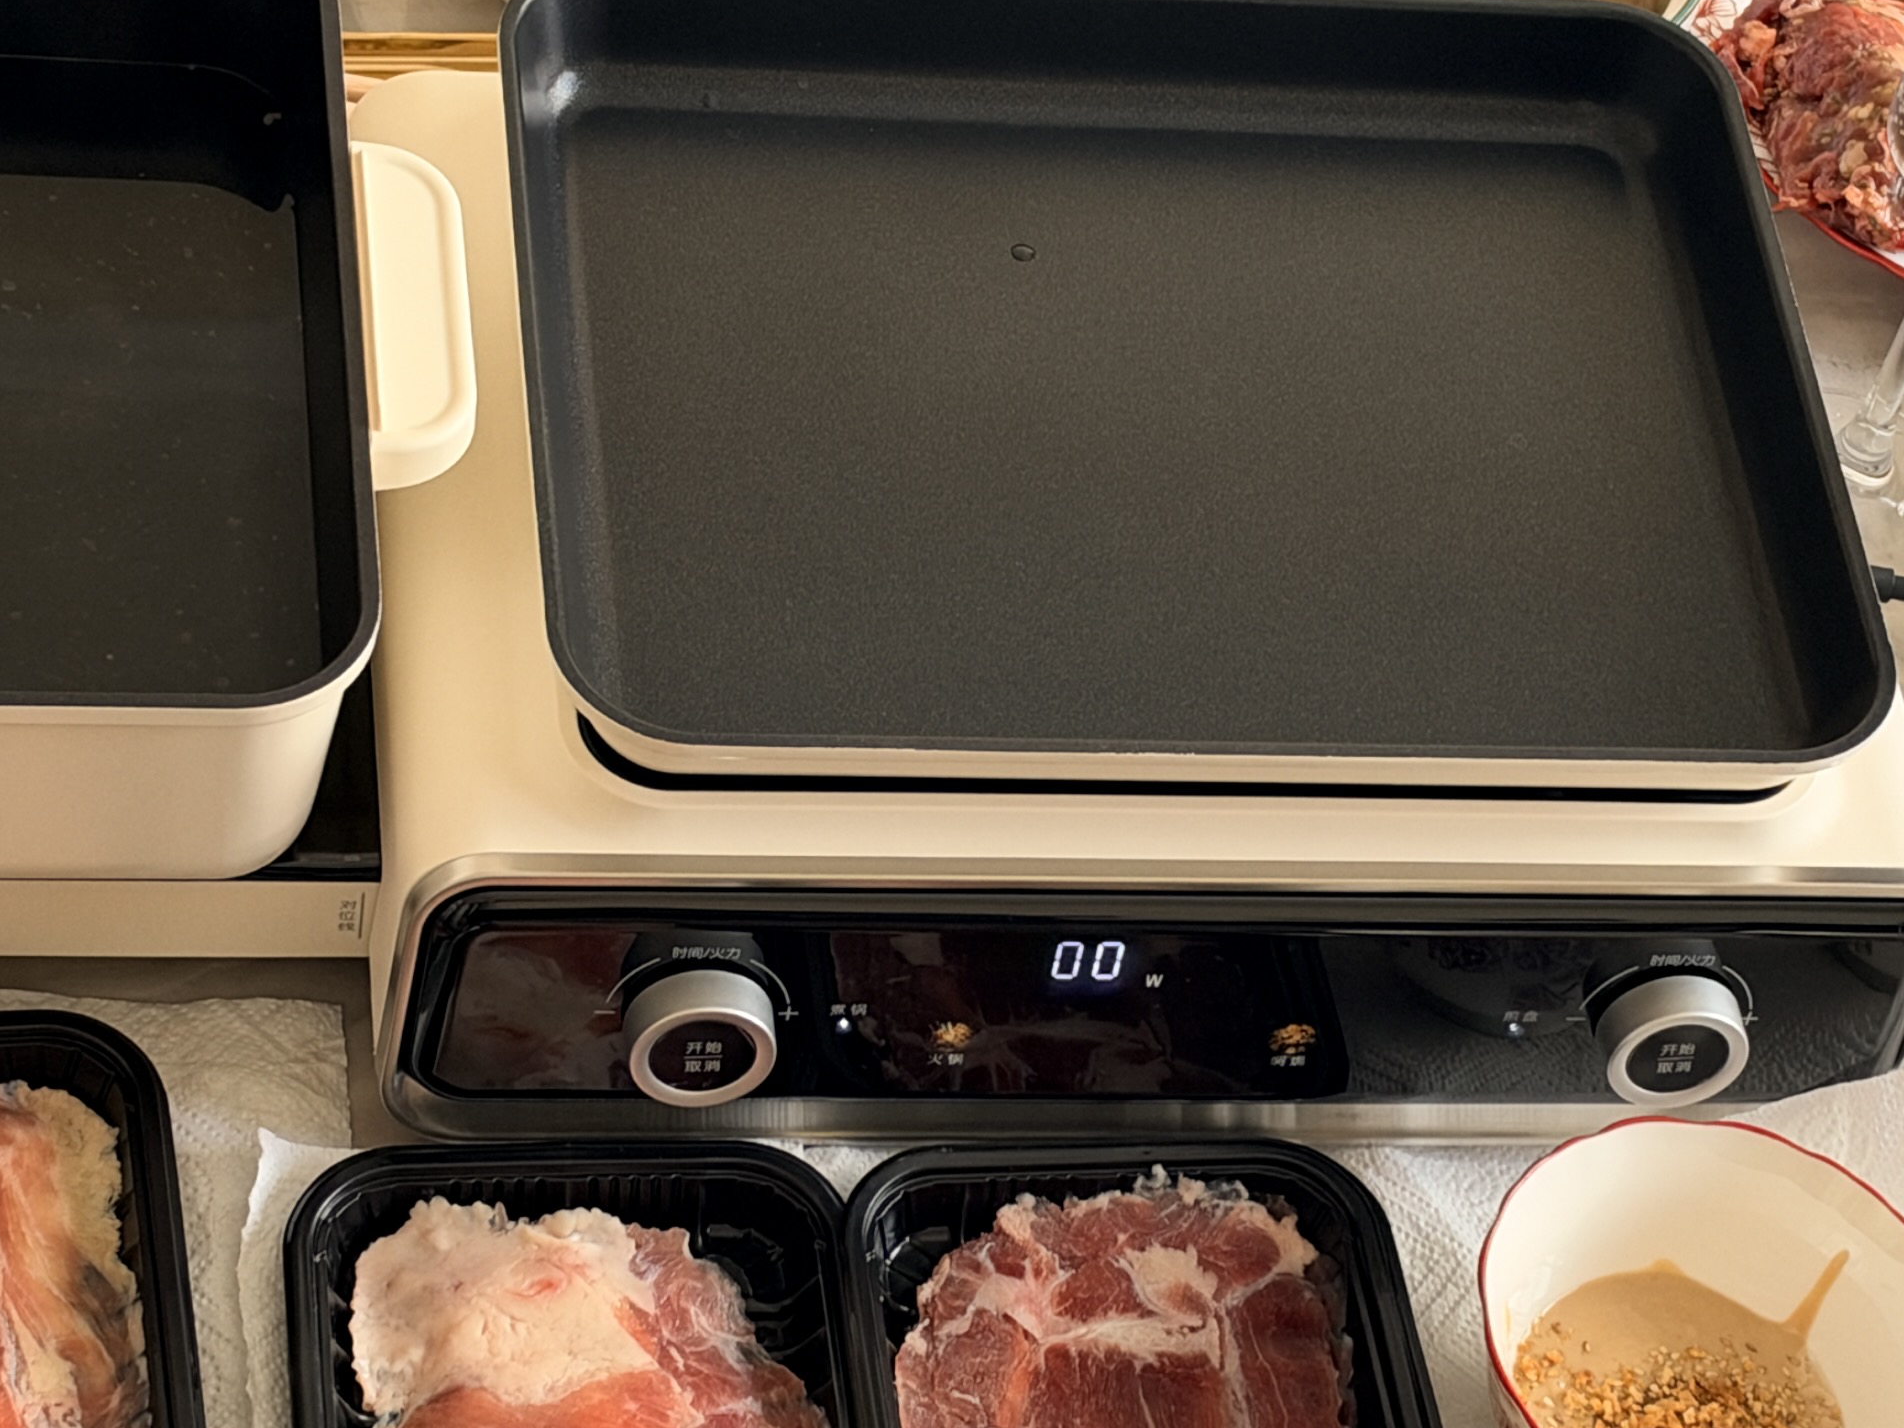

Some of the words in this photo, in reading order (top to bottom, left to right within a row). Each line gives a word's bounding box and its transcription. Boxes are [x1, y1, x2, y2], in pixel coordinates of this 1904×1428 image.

[671, 945, 742, 961] 时间/火力
[1649, 953, 1717, 967] 时间/火力
[685, 1041, 723, 1055] 开始
[1659, 1042, 1696, 1057] 开始
[684, 1060, 721, 1073] 取消
[1656, 1060, 1692, 1074] 取消
